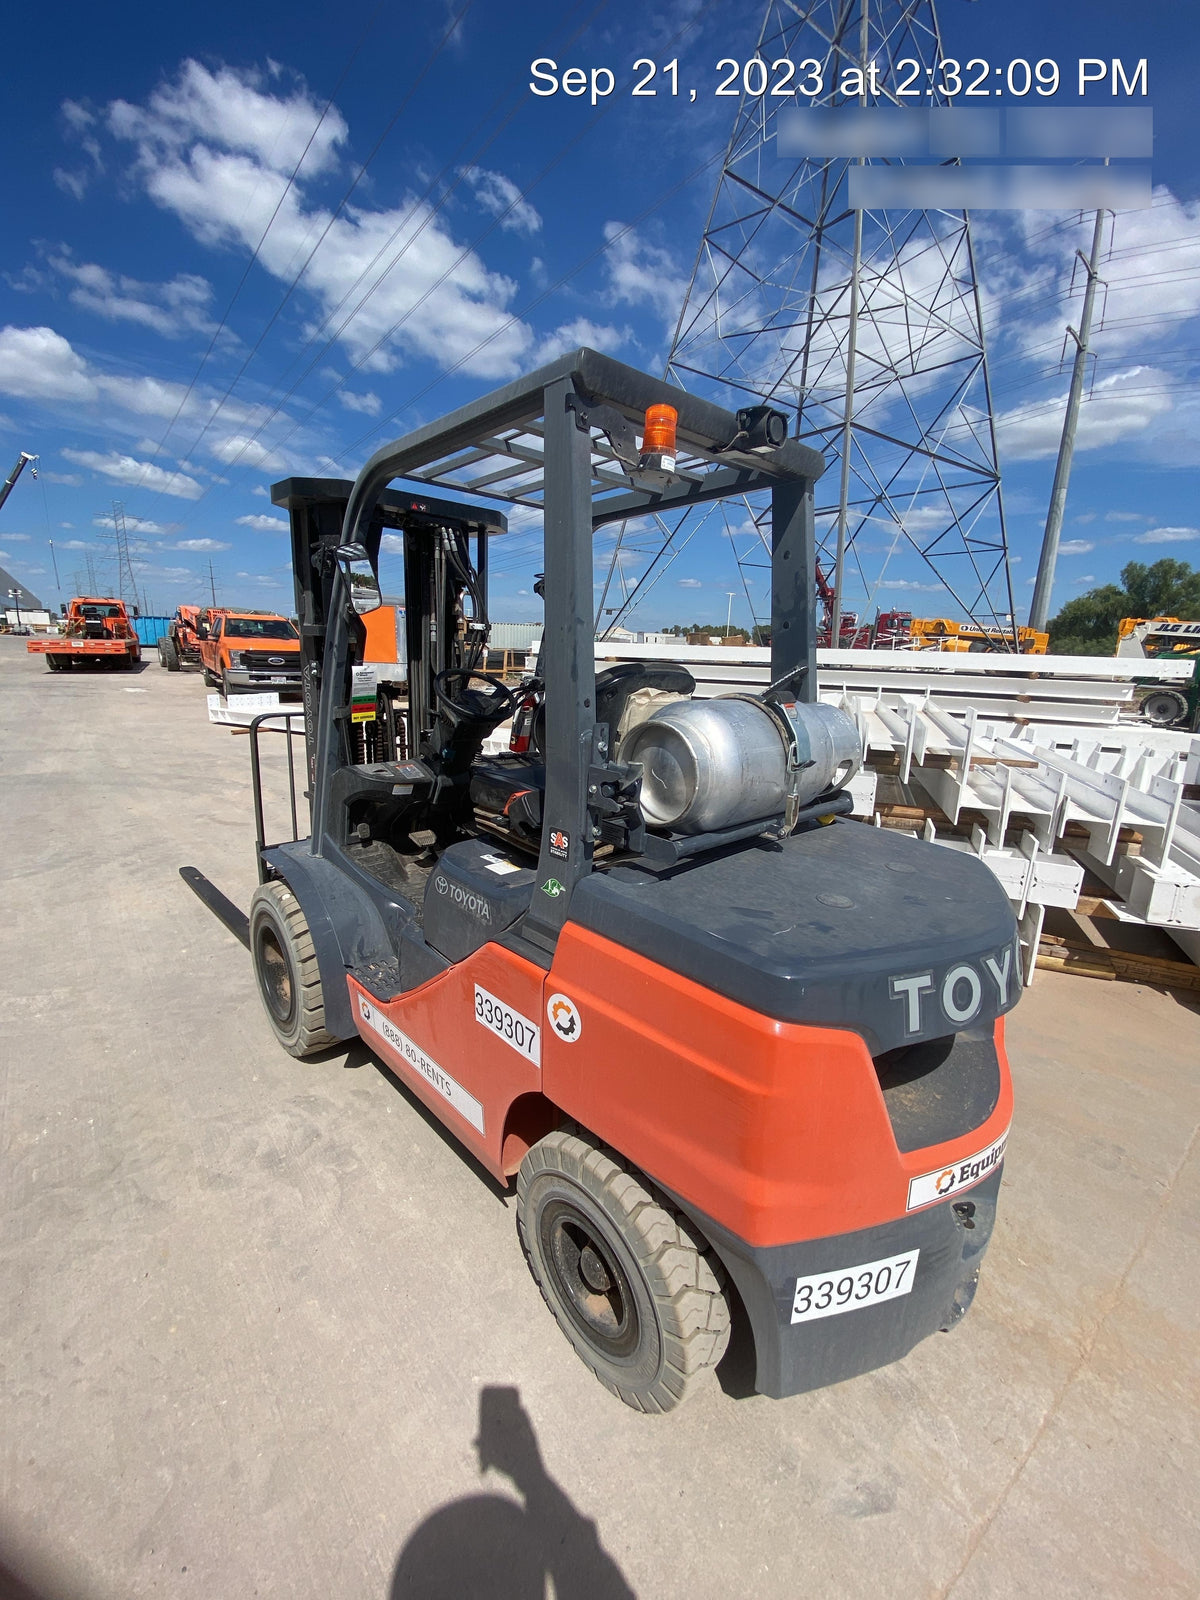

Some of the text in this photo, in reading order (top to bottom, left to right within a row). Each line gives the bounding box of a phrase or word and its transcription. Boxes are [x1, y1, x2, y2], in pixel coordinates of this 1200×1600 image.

[1153, 623, 1183, 633] JLG
[550, 831, 569, 849] SAS
[449, 884, 490, 919] TOYOTA
[475, 991, 536, 1054] 339307
[382, 1021, 452, 1097] (888) 80-RENTS
[794, 1259, 912, 1315] 339307
